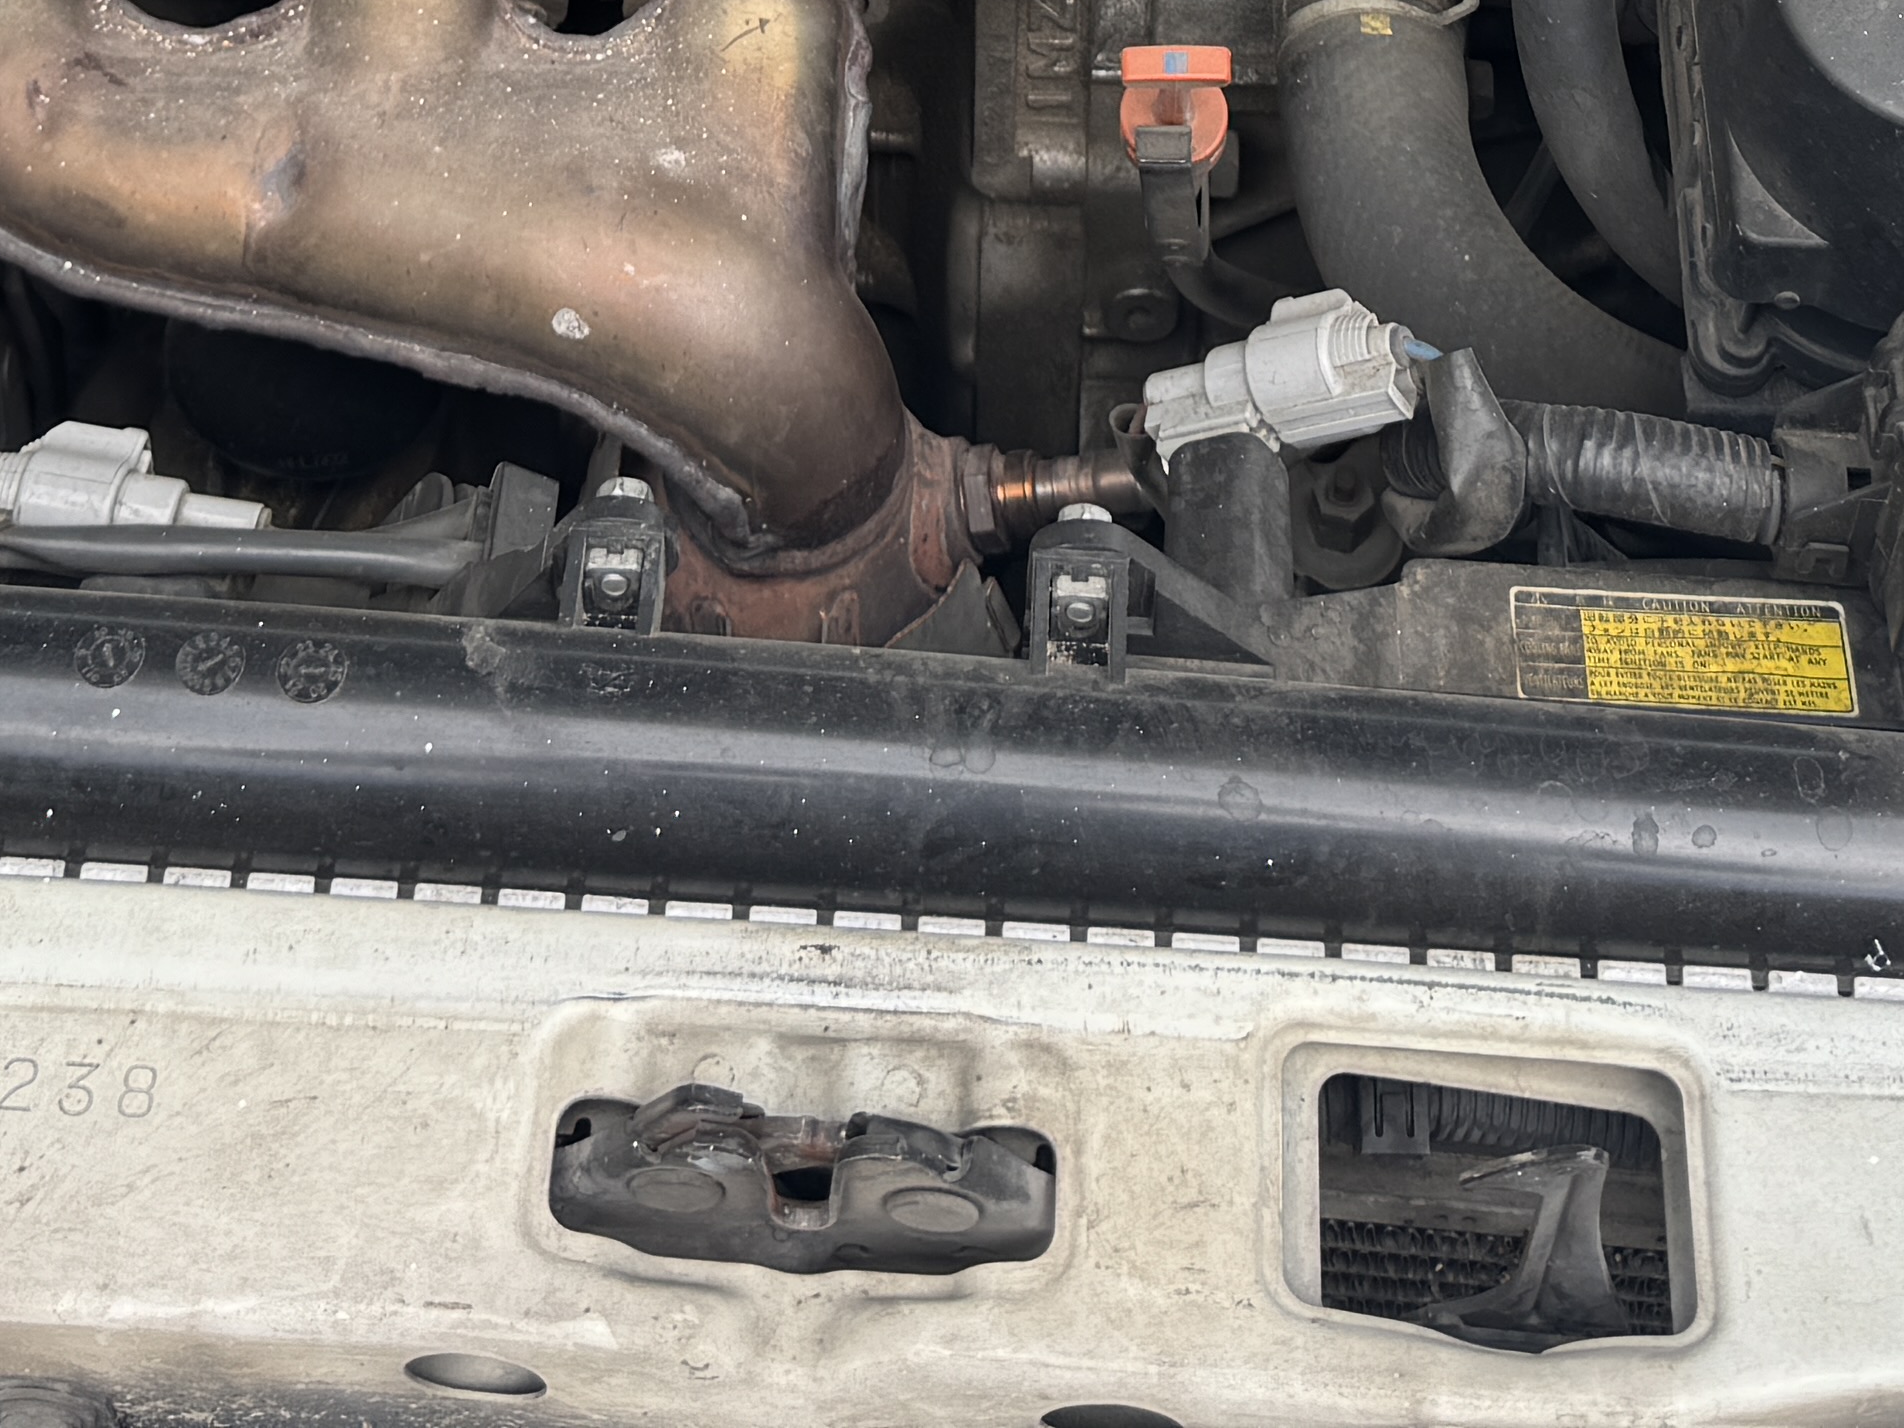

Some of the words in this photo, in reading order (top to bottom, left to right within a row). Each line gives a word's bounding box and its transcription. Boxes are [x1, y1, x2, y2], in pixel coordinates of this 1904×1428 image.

[1642, 598, 1710, 613] CAUTION
[1736, 603, 1821, 618] ATTENTION
[1605, 636, 1637, 648] AVOID
[1645, 638, 1697, 650] PERSONAL
